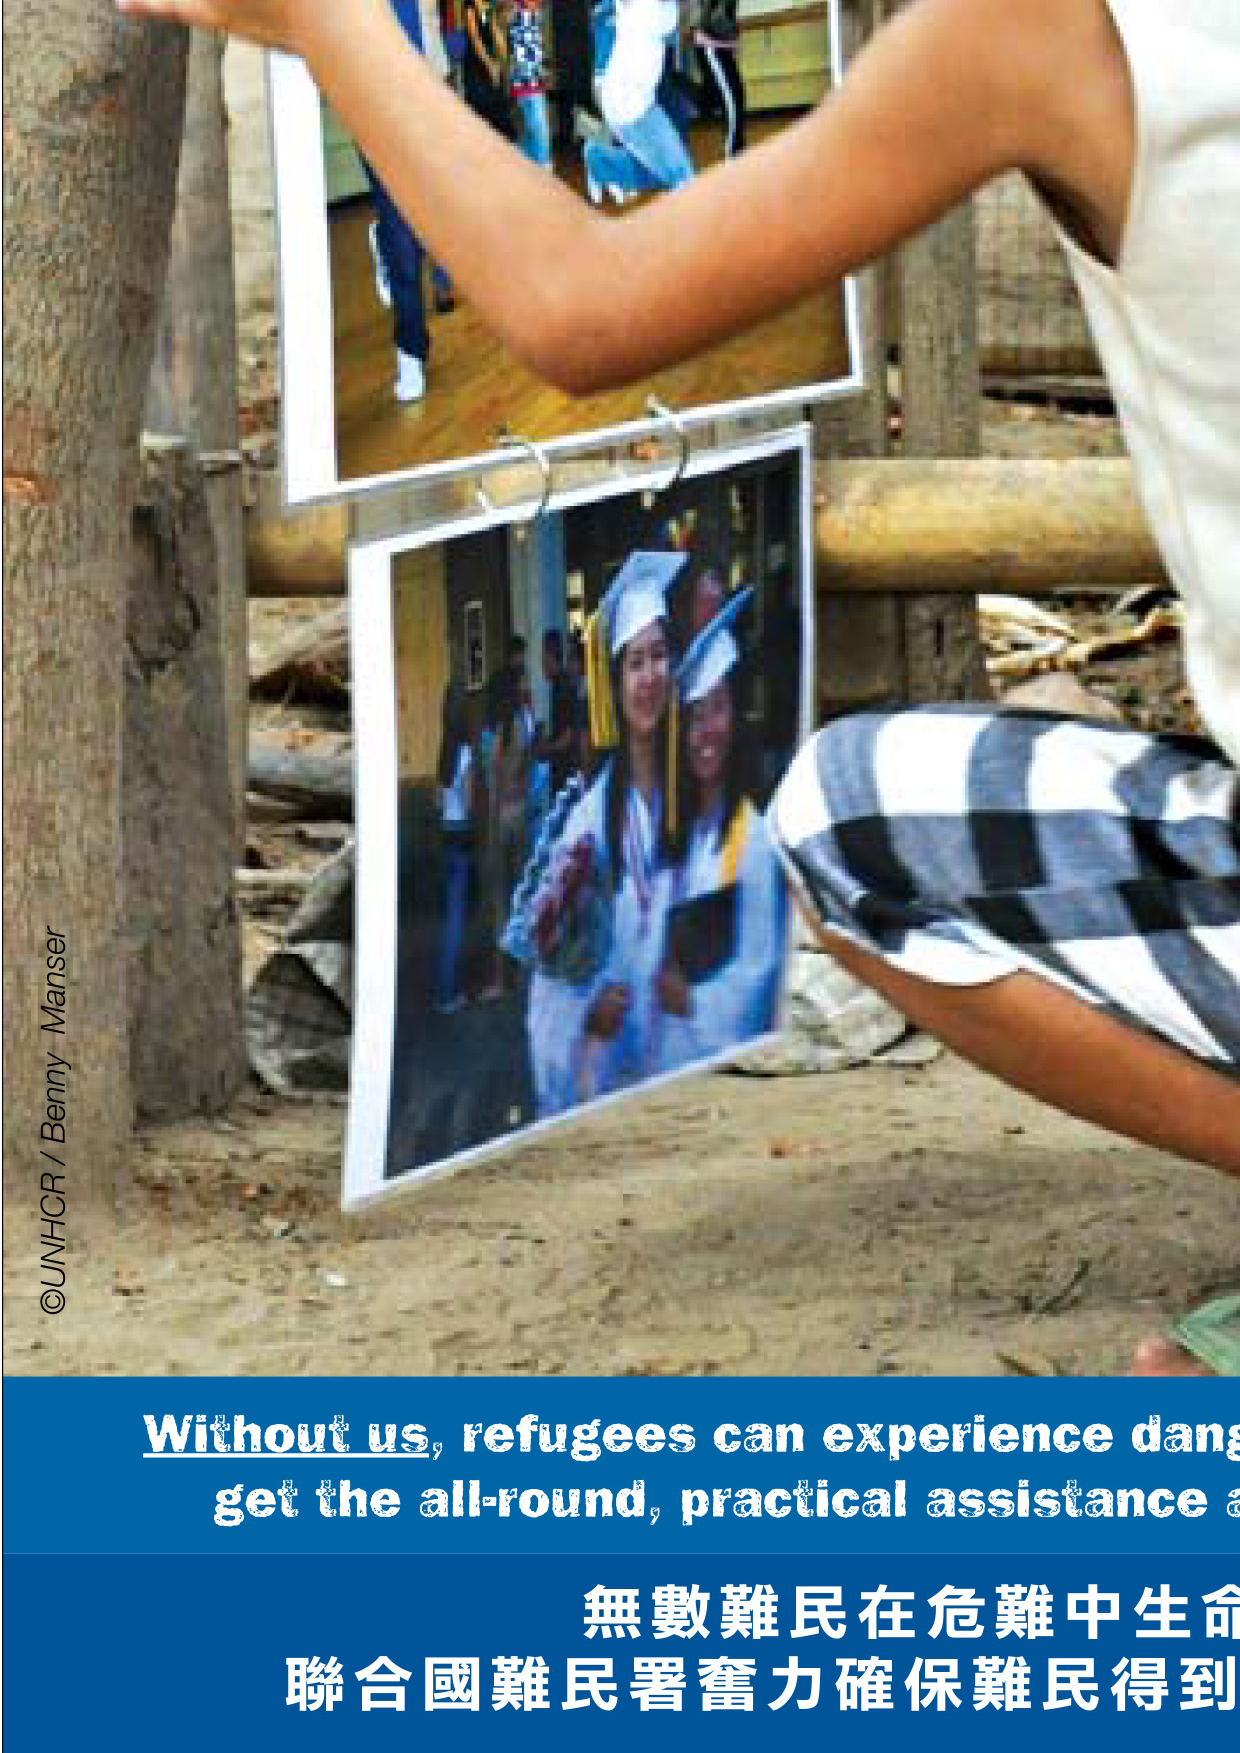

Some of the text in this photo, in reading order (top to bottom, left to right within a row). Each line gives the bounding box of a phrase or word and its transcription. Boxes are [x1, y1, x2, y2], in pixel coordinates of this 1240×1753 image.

[143, 1415, 349, 1452] Without
[369, 1424, 442, 1459] us,
[464, 1414, 695, 1459] refugees
[714, 1423, 803, 1452] can
[823, 1415, 1113, 1459] experience
[214, 1480, 298, 1526] get
[316, 1480, 400, 1517] the
[420, 1480, 659, 1525] all-round,
[682, 1480, 906, 1526] practical
[927, 1480, 1207, 1518] assistance
